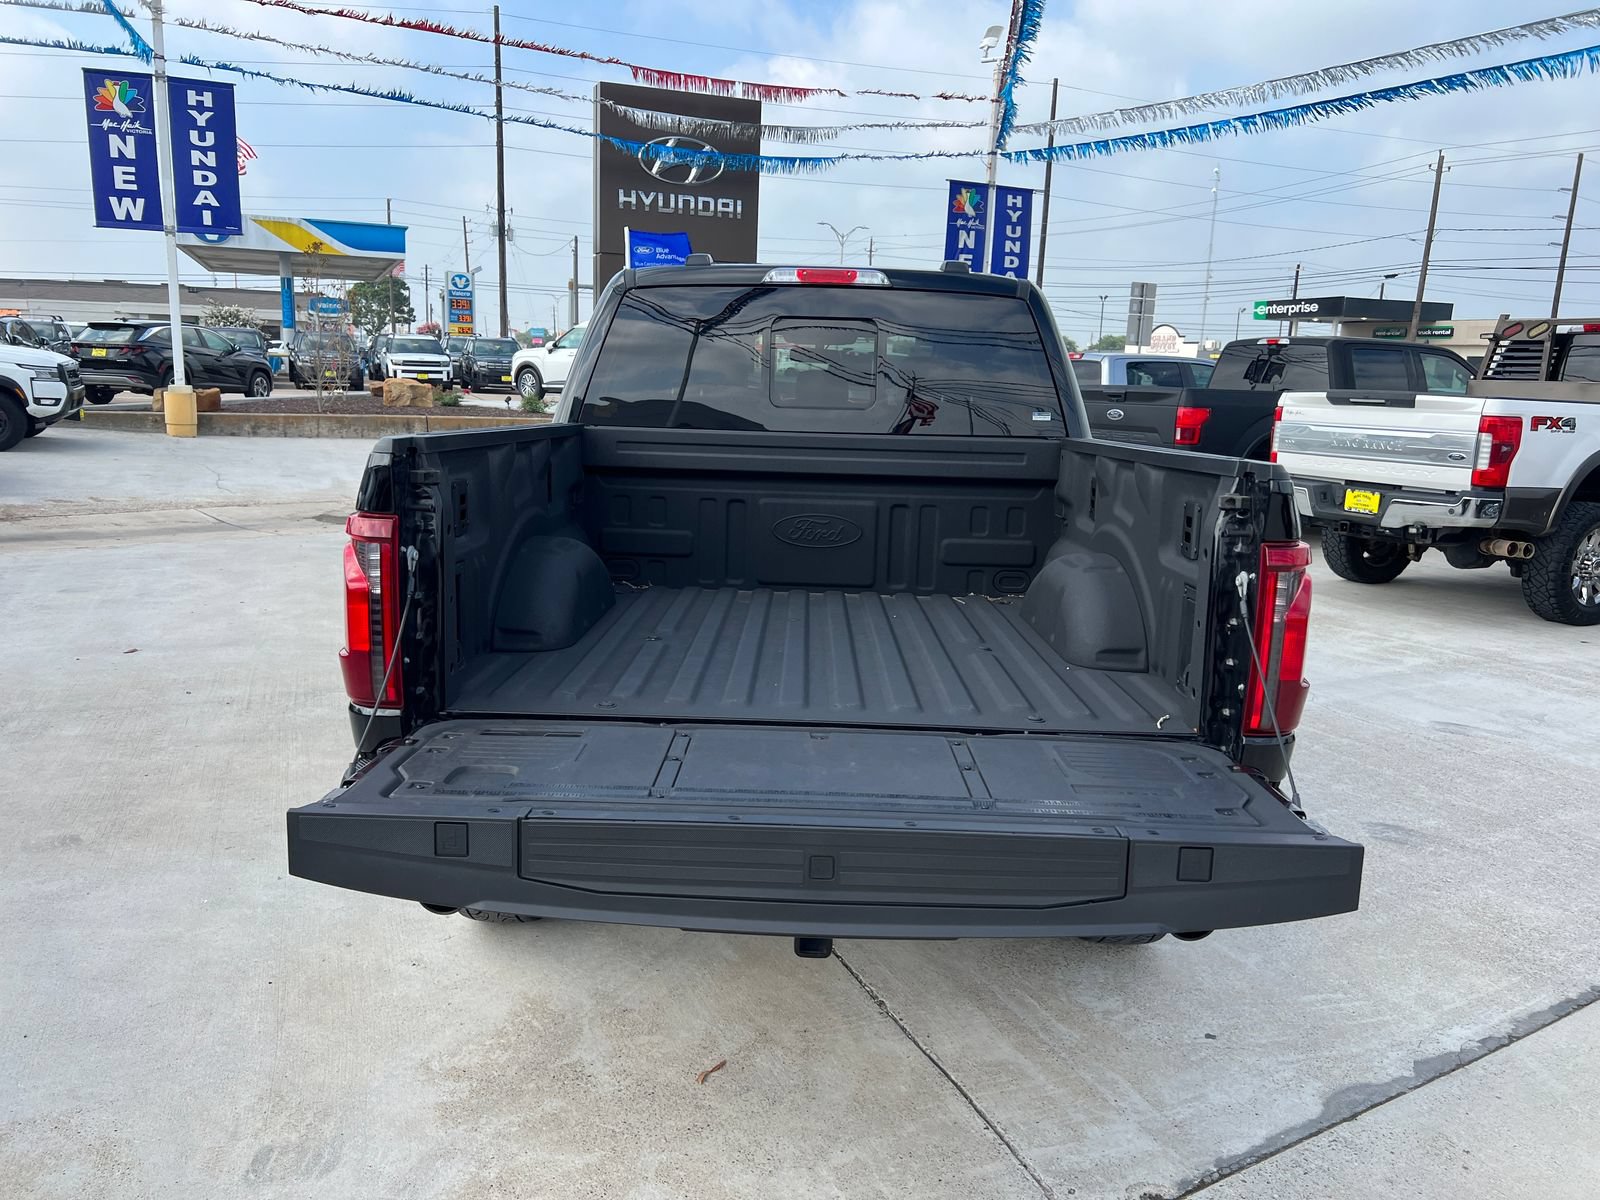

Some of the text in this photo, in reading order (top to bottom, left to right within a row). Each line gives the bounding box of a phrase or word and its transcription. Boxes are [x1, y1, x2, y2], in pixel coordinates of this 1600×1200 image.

[187, 90, 220, 226] HYUNDAI
[108, 134, 145, 222] NEW
[618, 188, 742, 219] HYUNDAI
[1256, 301, 1319, 317] enterprise
[1530, 416, 1577, 431] FX4
[788, 517, 844, 541] Ford
